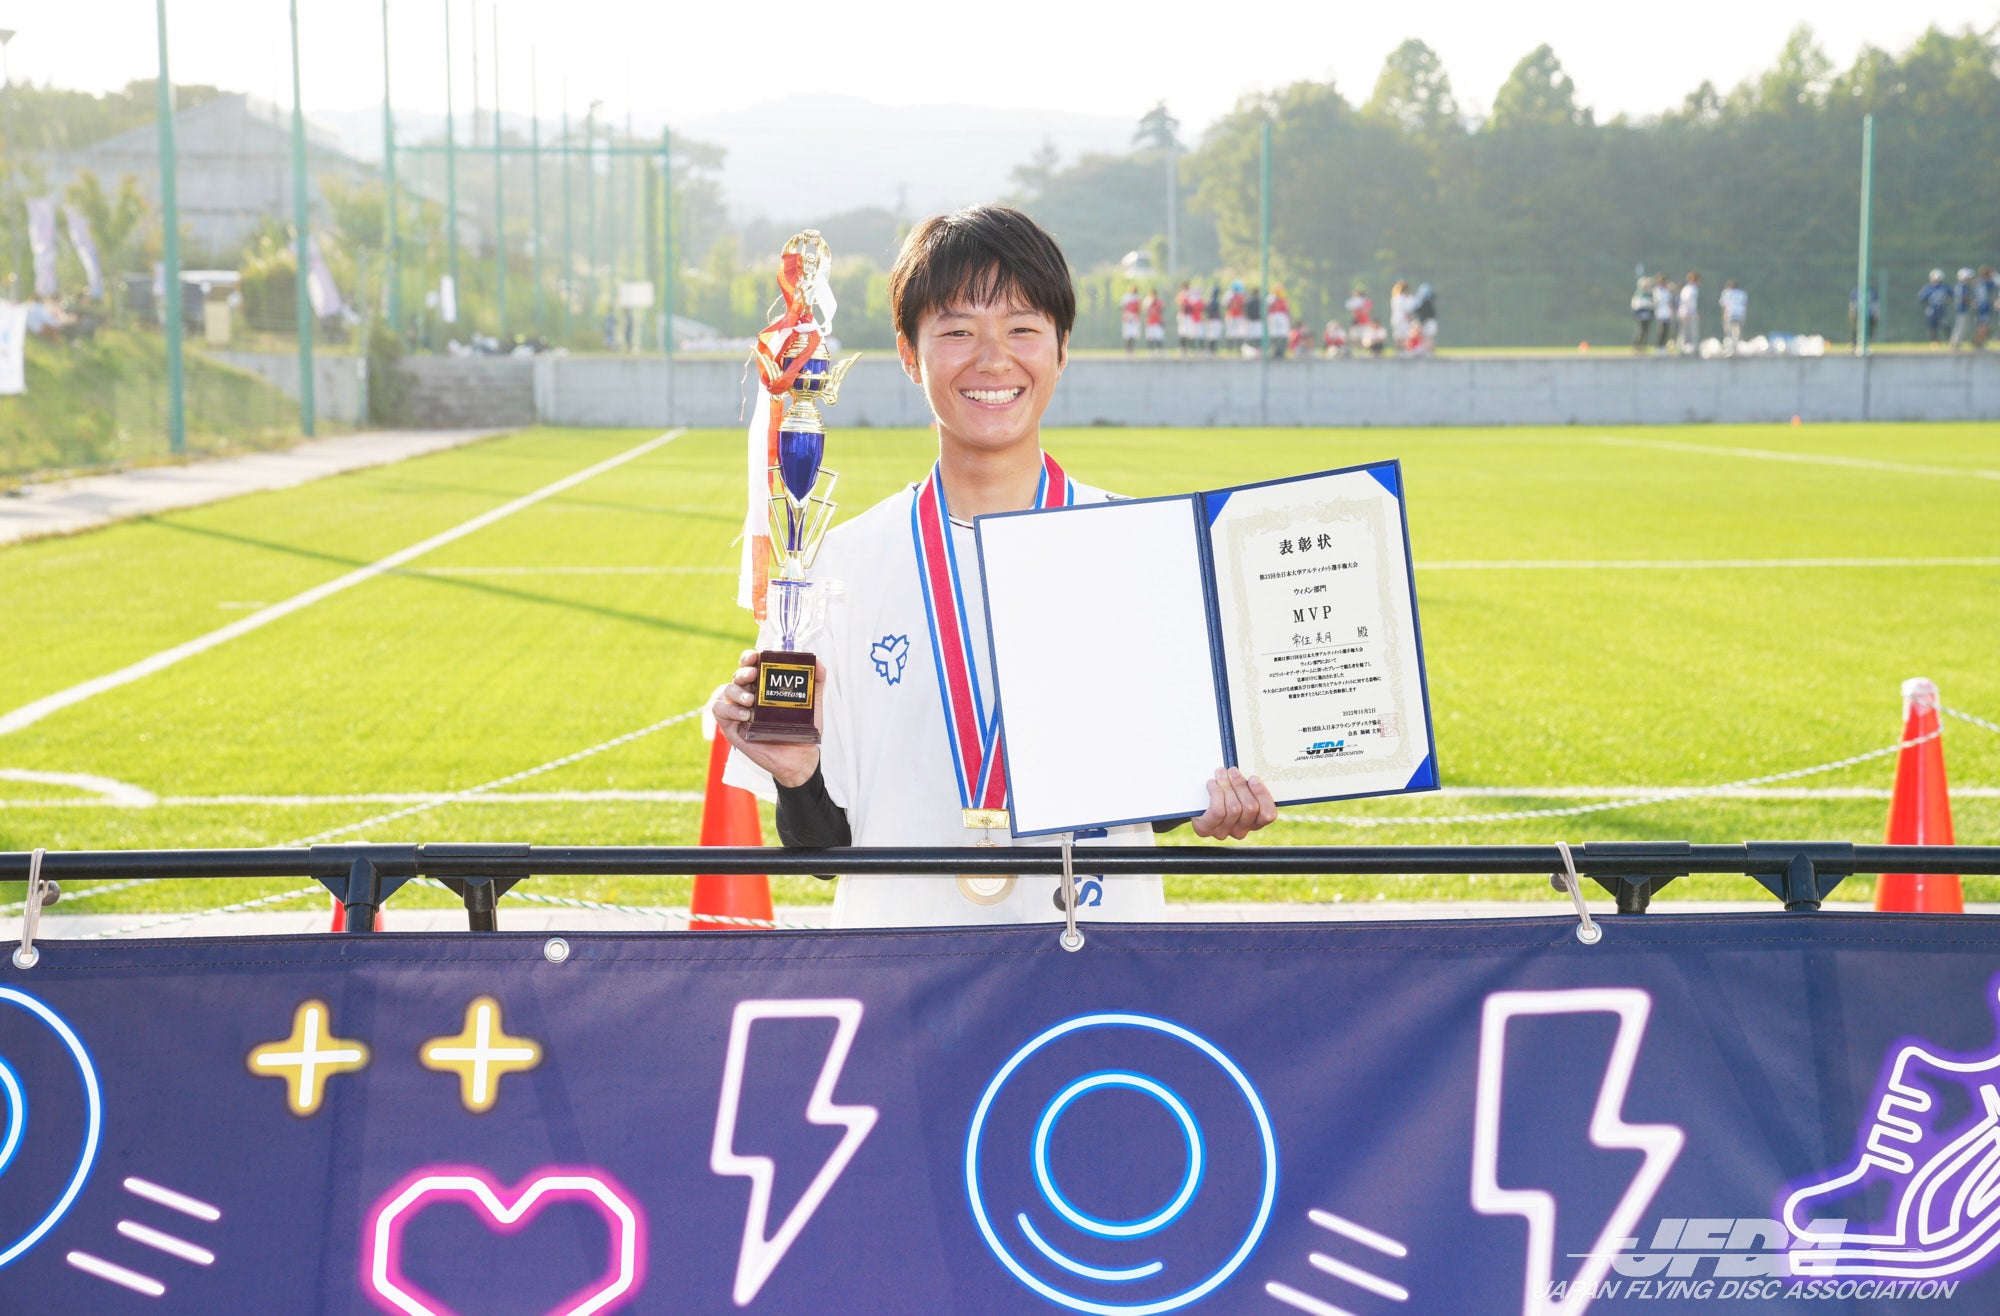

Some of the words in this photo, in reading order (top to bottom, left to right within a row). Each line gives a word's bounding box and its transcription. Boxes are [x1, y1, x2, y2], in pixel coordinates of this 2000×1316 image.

[1280, 533, 1332, 555] 表彰状
[1293, 584, 1327, 596] ウィメン部門
[1293, 605, 1332, 623] MVP
[1357, 626, 1368, 638] 殿
[770, 674, 804, 688] MVP
